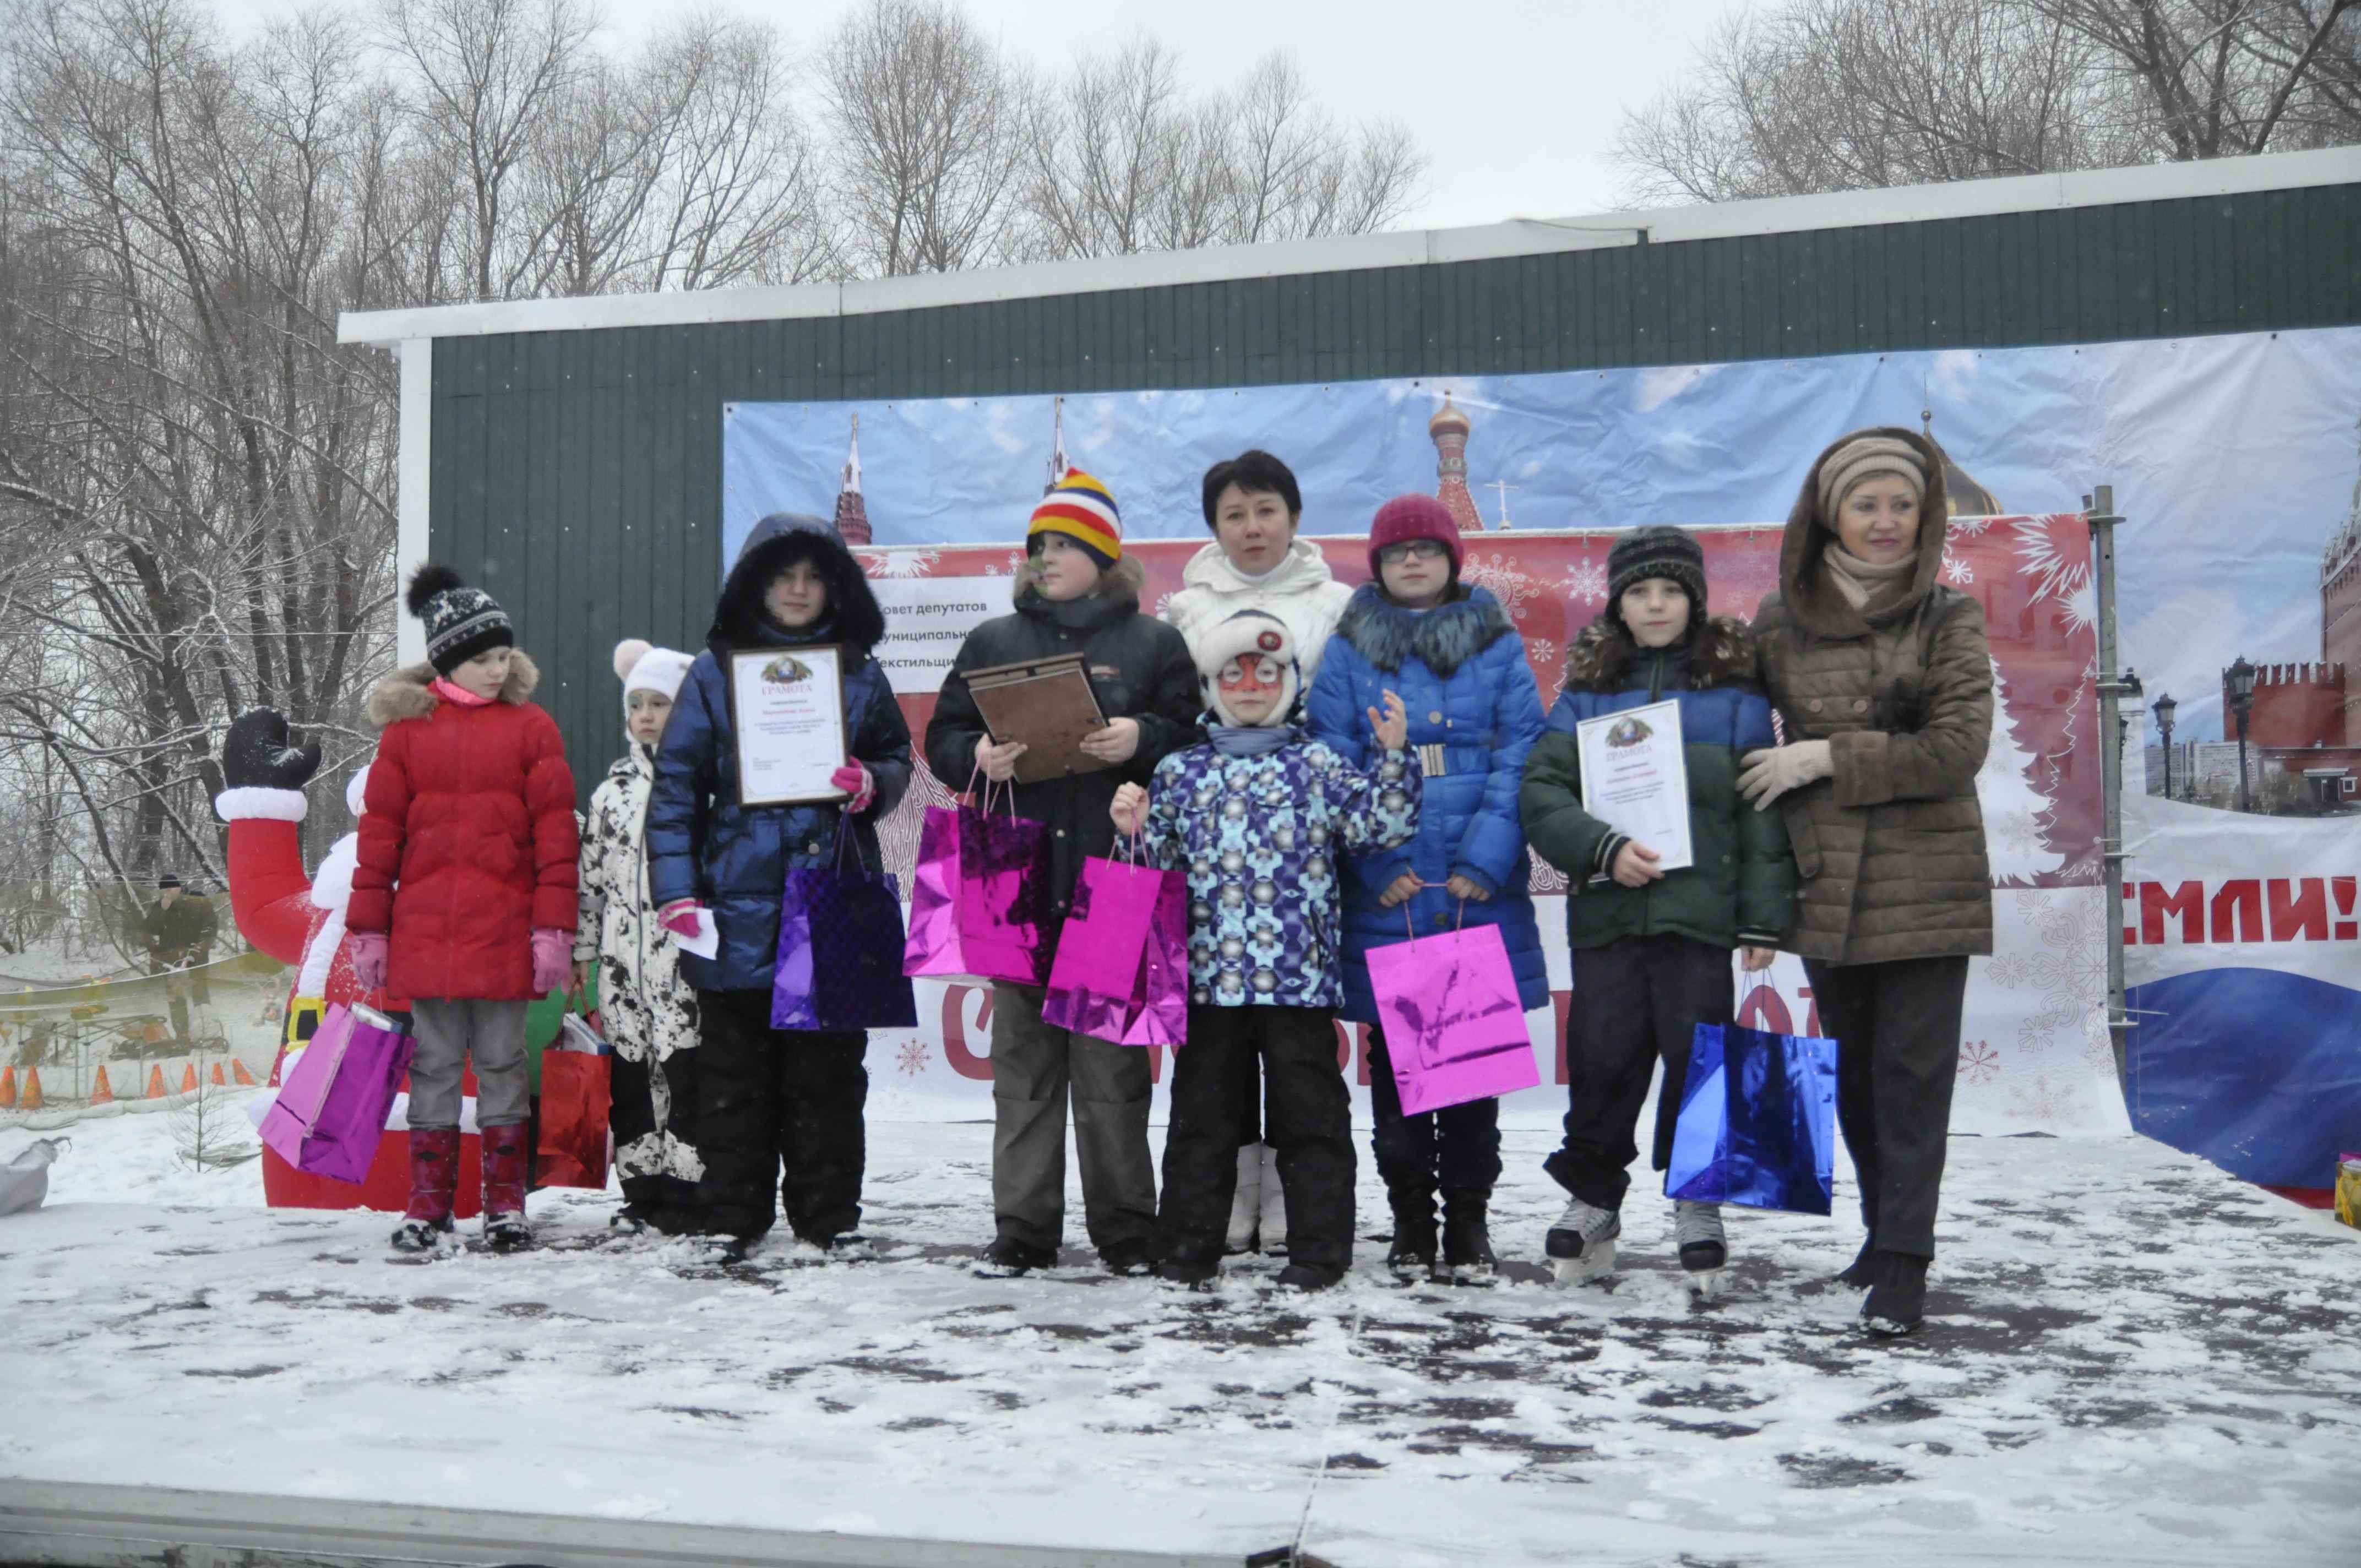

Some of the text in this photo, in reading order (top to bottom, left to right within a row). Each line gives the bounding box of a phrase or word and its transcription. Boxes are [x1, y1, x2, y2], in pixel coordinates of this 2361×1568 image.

[882, 603, 987, 616] овет депутатов
[882, 631, 967, 644] униципальн
[875, 657, 955, 668] екстильщи
